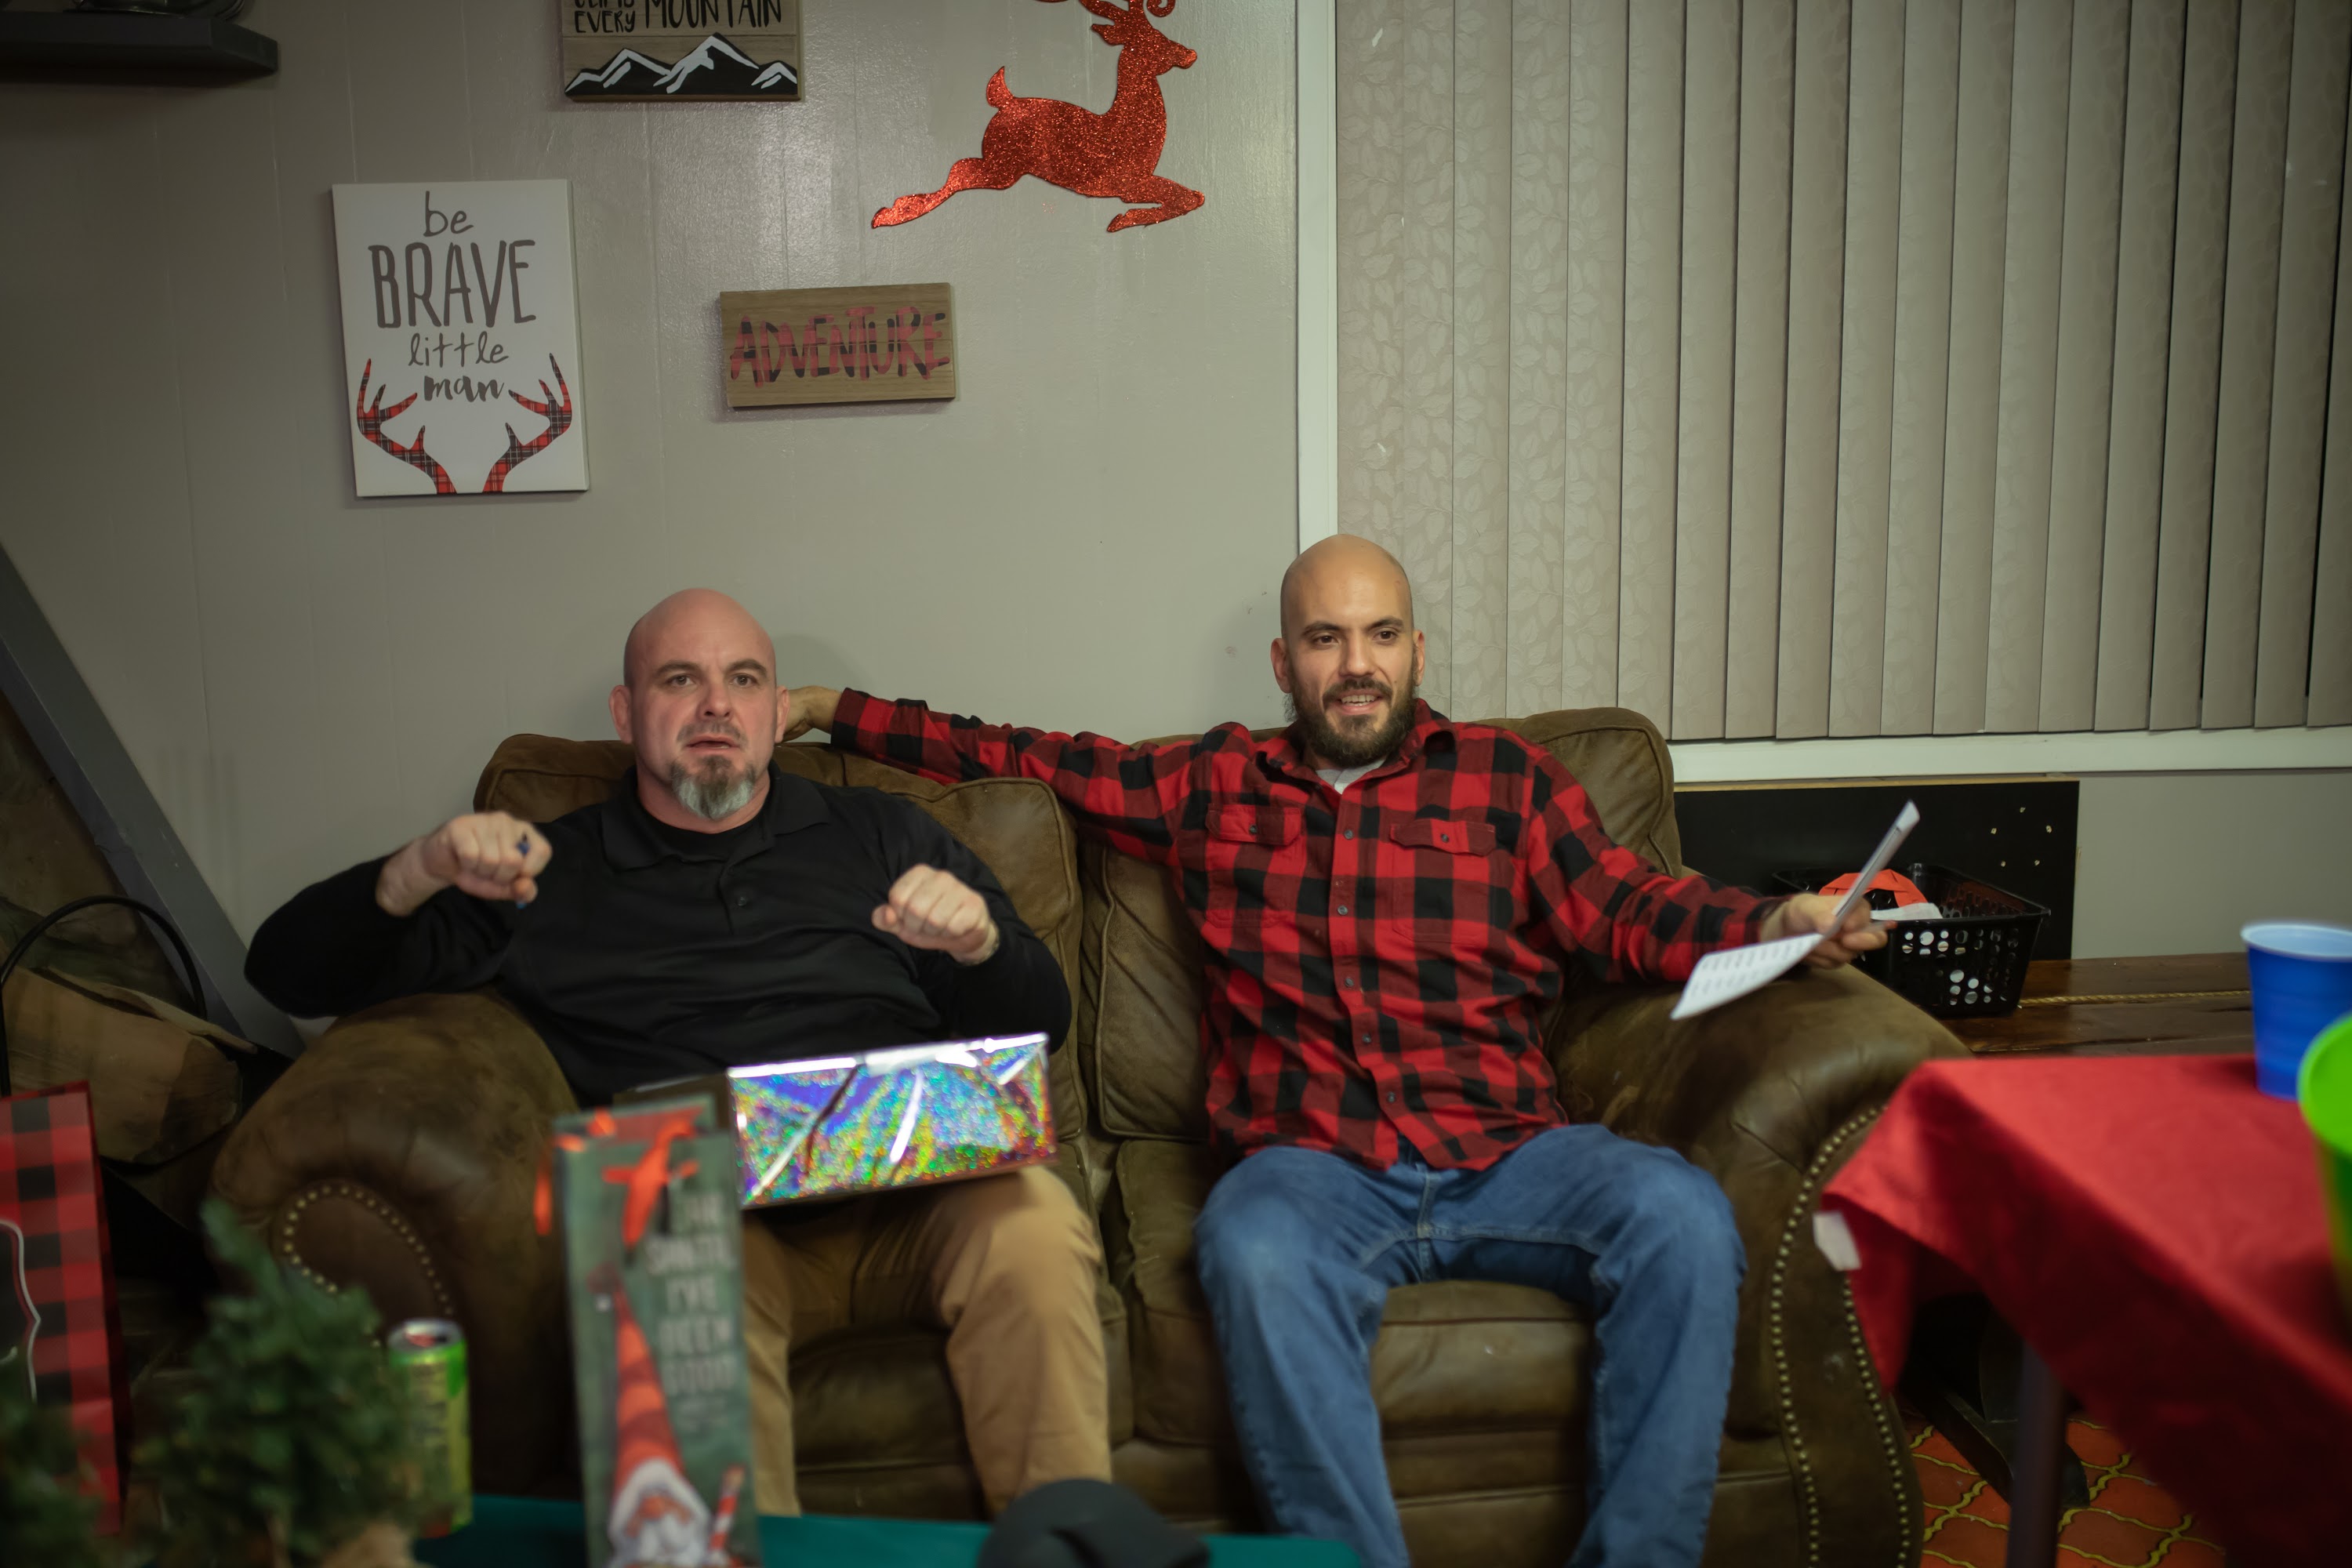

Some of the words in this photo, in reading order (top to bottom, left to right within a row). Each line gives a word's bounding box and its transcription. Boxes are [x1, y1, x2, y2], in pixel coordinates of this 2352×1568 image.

[574, 10, 636, 33] EVERY
[644, 0, 782, 29] MOUNTAIN
[423, 191, 474, 237] be
[368, 239, 536, 328] BRAVE
[408, 331, 509, 368] little
[730, 306, 950, 388] ADVENTURE
[423, 375, 504, 402] man
